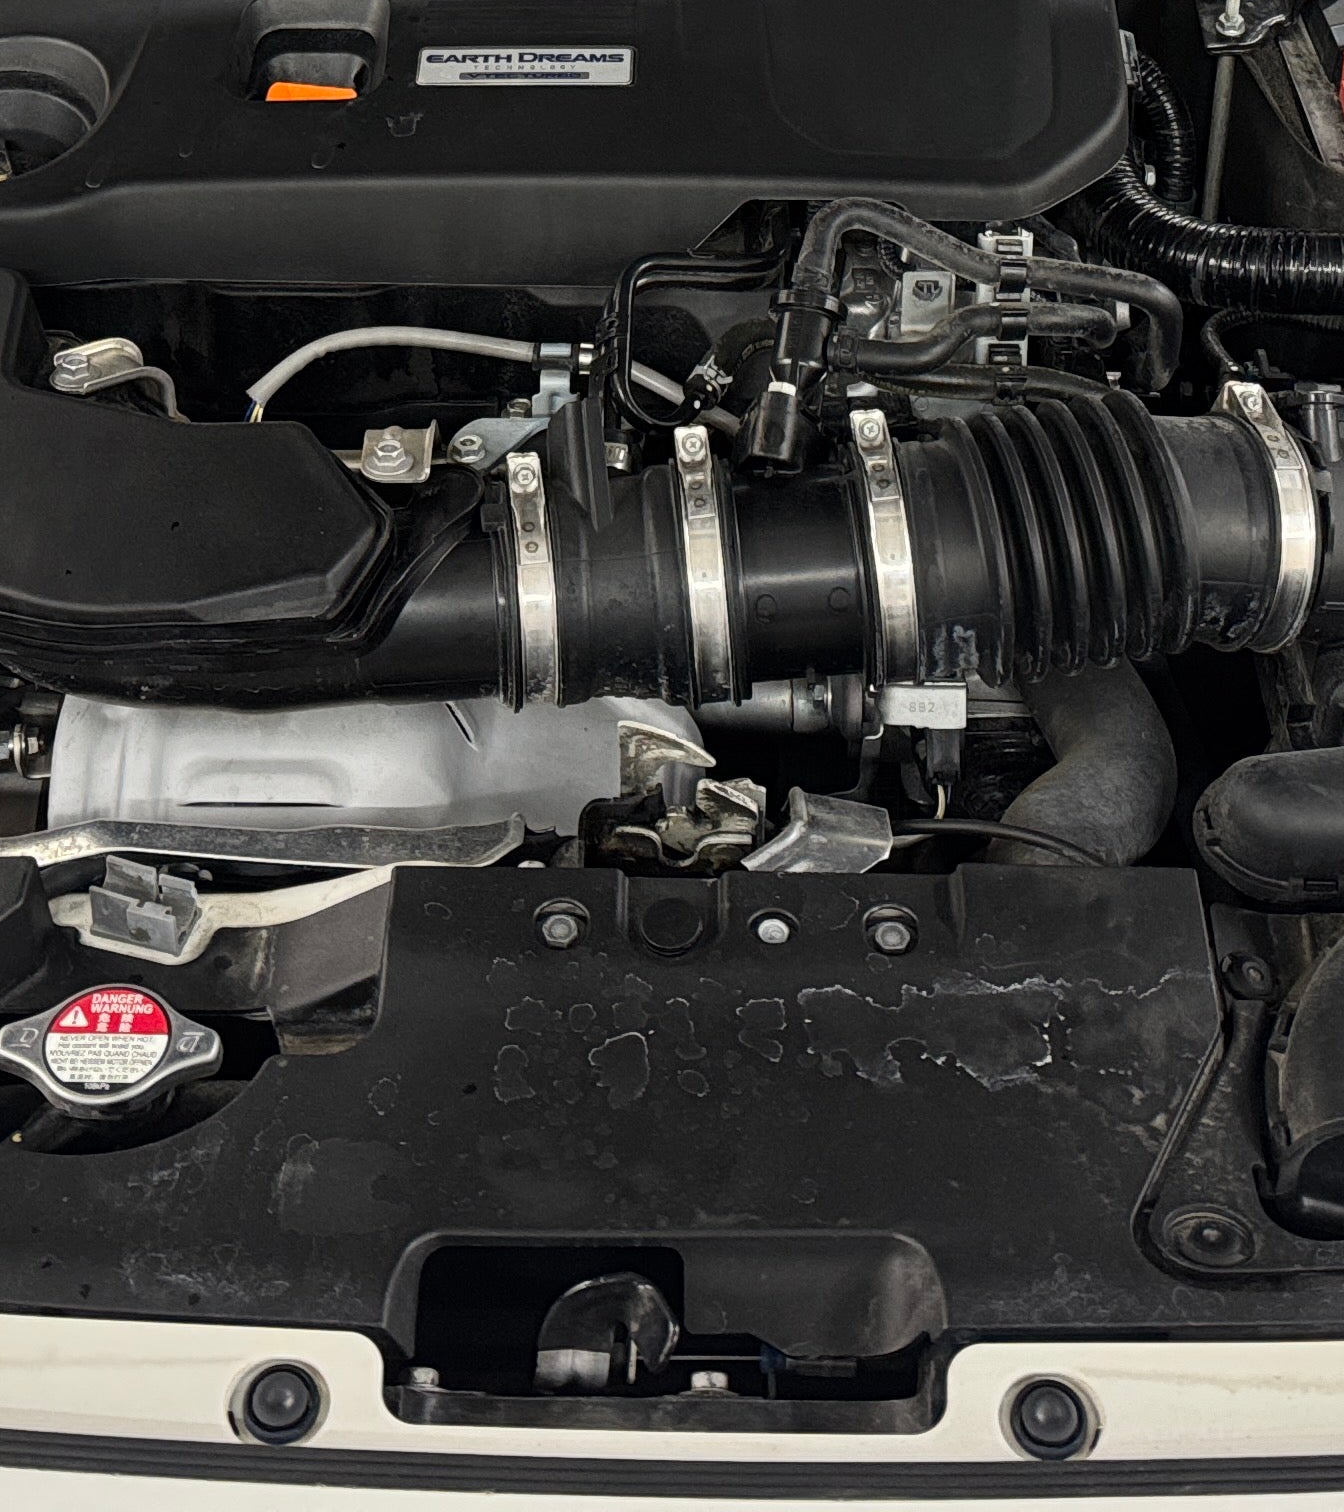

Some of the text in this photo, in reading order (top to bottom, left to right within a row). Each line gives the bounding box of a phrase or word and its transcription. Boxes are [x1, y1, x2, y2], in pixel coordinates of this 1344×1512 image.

[426, 52, 624, 64] EARTH DREAMS
[91, 993, 143, 1004] DANGER
[90, 1003, 153, 1014] WARNUNG
